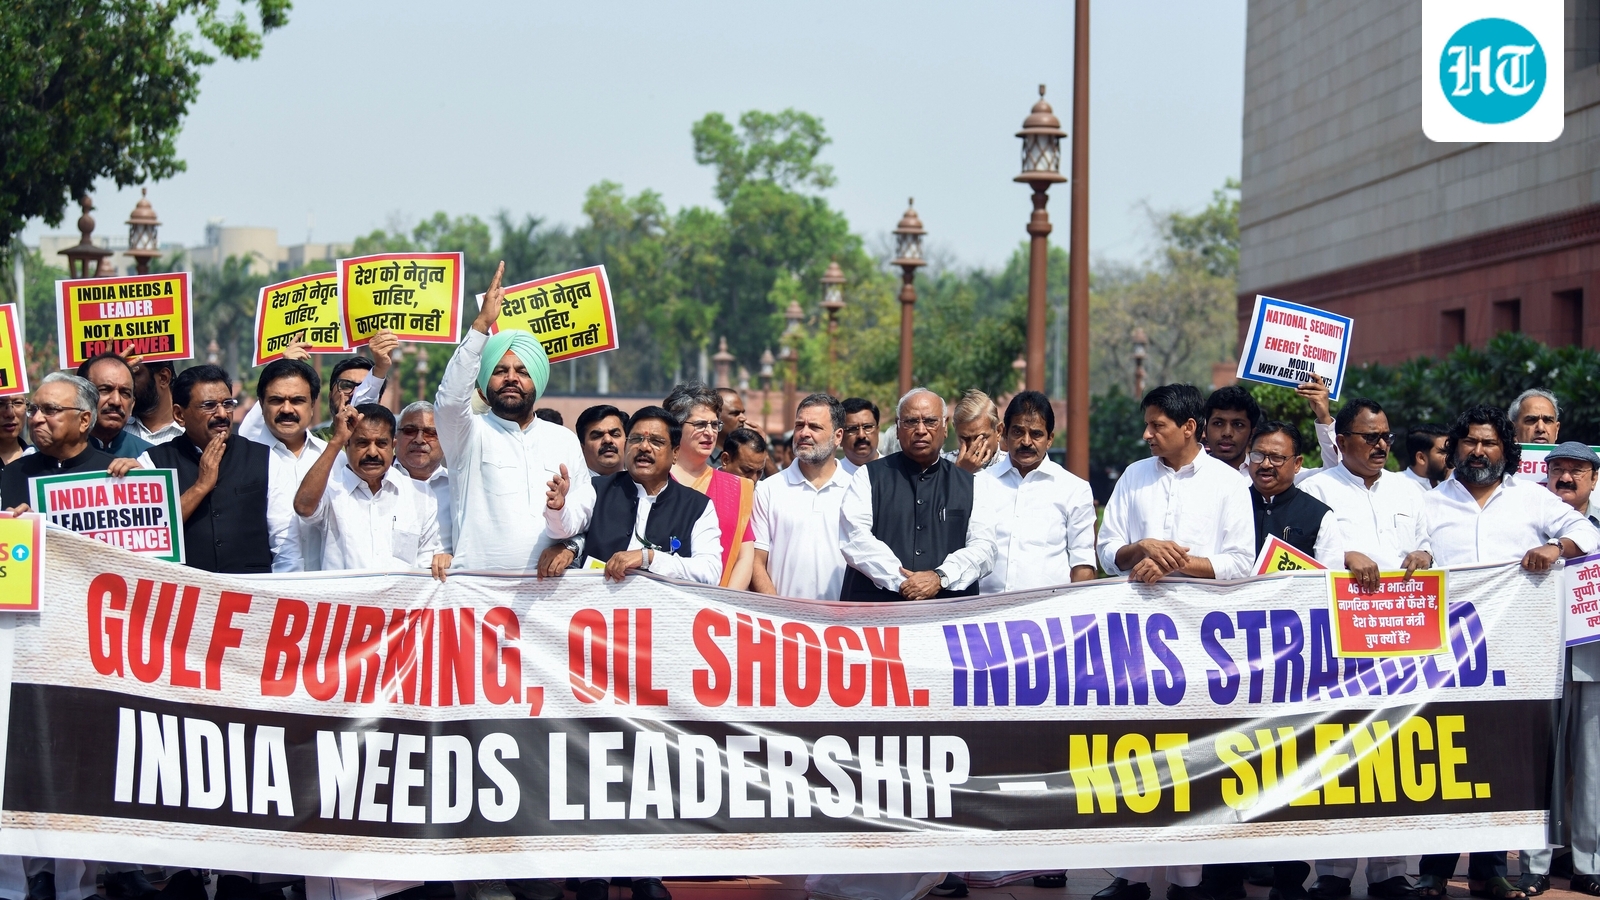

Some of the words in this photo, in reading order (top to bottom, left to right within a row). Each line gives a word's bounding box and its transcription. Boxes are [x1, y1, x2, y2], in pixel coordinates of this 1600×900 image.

[355, 265, 378, 285] देश
[380, 261, 400, 281] को
[403, 261, 446, 289] नेतृत्व
[77, 286, 116, 301] INDIA
[119, 282, 161, 299] NEEDS
[164, 281, 173, 295] A
[271, 291, 289, 309] देश
[292, 284, 307, 302] को
[373, 285, 418, 308] चाहिए,
[501, 297, 527, 317] देश
[527, 288, 550, 310] को
[550, 281, 592, 309] नेतृत्व
[100, 300, 153, 318] LEADER
[284, 303, 319, 325] चाहिए,
[84, 324, 111, 338] NOT
[114, 323, 123, 337] A
[126, 320, 170, 336] SILENT
[310, 322, 340, 343] नहीं
[355, 312, 406, 334] कायरता
[409, 309, 445, 332] नहीं
[528, 309, 576, 334] चाहिए,
[1265, 309, 1307, 330] NATIONAL
[1310, 319, 1343, 340] SECURITY
[570, 323, 600, 348] नहीं
[85, 336, 169, 358] FOLOWER
[1264, 336, 1301, 355] ENERGY
[1302, 345, 1337, 364] SECURITY
[1258, 363, 1278, 375] WHY
[1277, 367, 1294, 379] ARE
[1294, 371, 1310, 383] YOU
[1288, 358, 1308, 371] MODI
[49, 485, 109, 511] INDIA
[112, 482, 163, 505] NEED
[52, 507, 167, 532] LEADERSHIP,
[1348, 583, 1359, 594] 46
[1387, 579, 1424, 593] भारतीय
[1572, 582, 1595, 602] चुप्पी
[1338, 597, 1370, 611] नागरिक
[1371, 599, 1394, 610] गल्फ
[1395, 596, 1406, 609] में
[1571, 600, 1598, 614] भारत
[1352, 614, 1366, 628] देश
[1368, 614, 1377, 627] के
[1378, 616, 1404, 628] प्रधान
[1405, 612, 1425, 627] मंत्री
[87, 573, 253, 691] GULF
[261, 598, 545, 716] BURNING,
[568, 608, 668, 706] OIL
[692, 607, 930, 708] SHOCK.
[942, 611, 1187, 707] INDIANS
[1365, 634, 1378, 648] चुप
[1379, 631, 1396, 645] क्यों
[114, 707, 295, 818] INDIA
[316, 729, 521, 824] NEEDS
[548, 731, 971, 821] LEADERSHIP
[1068, 732, 1191, 815] NOT
[1215, 714, 1491, 812] SILENCE.
